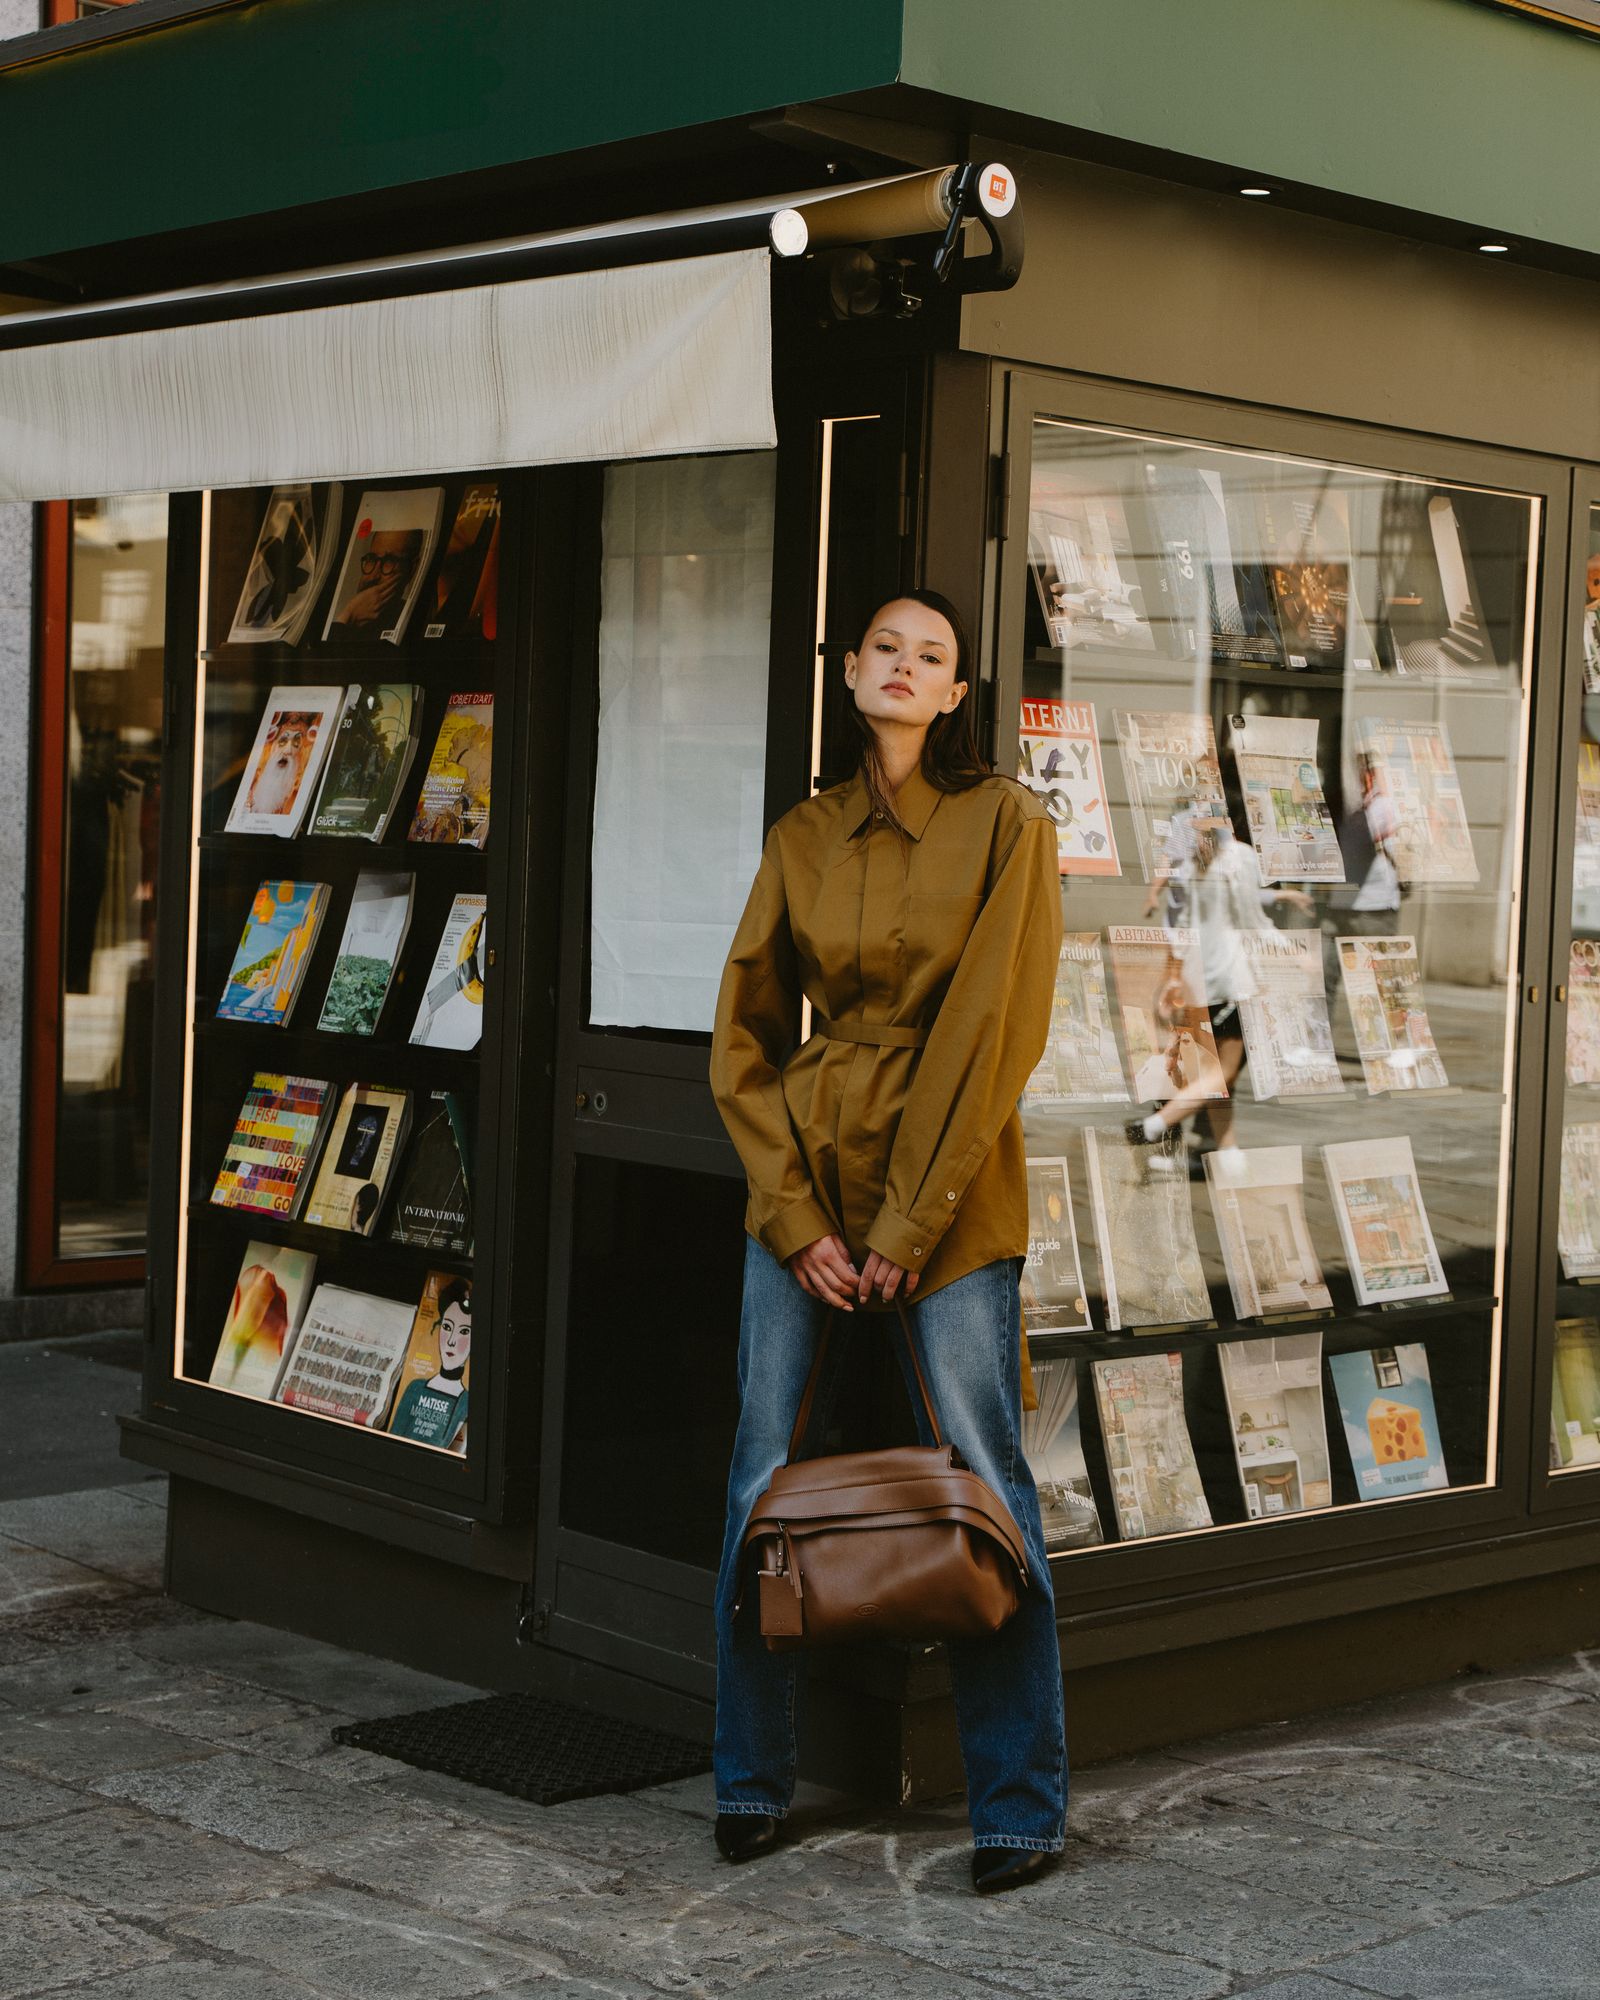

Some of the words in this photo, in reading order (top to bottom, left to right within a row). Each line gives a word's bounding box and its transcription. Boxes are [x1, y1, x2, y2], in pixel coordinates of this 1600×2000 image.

[342, 718, 353, 729] 30
[1114, 928, 1169, 943] ABITARE
[255, 1107, 279, 1124] FISH
[248, 1135, 267, 1150] DIE
[273, 1196, 291, 1212] GO
[405, 1205, 466, 1223] INTERNATIONAL
[1037, 1238, 1061, 1255] guide
[1024, 1254, 1044, 1267] 025
[418, 1395, 450, 1413] MATISSE
